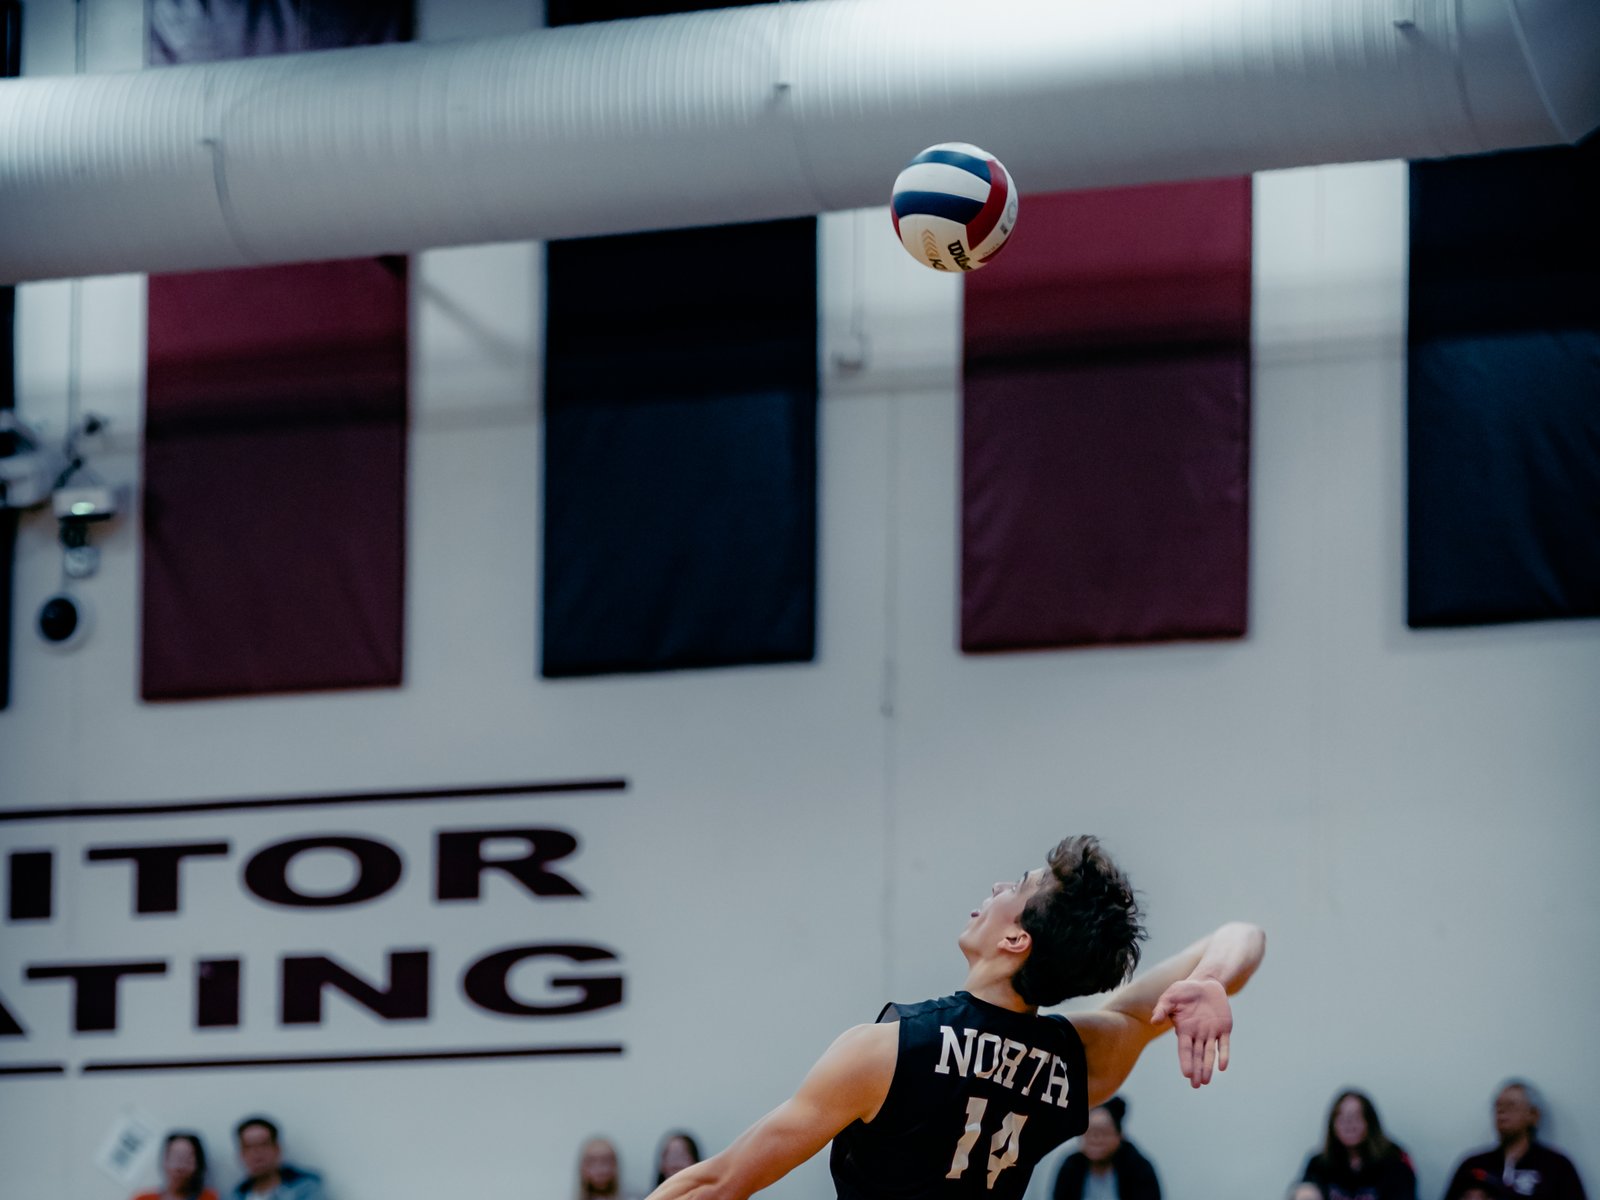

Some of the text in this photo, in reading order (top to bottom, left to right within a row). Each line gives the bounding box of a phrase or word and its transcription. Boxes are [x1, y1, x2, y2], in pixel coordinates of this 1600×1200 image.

[9, 827, 588, 919] ITOR
[0, 943, 624, 1035] TING
[934, 1025, 1070, 1109] NORTH
[945, 1096, 1029, 1190] 14
